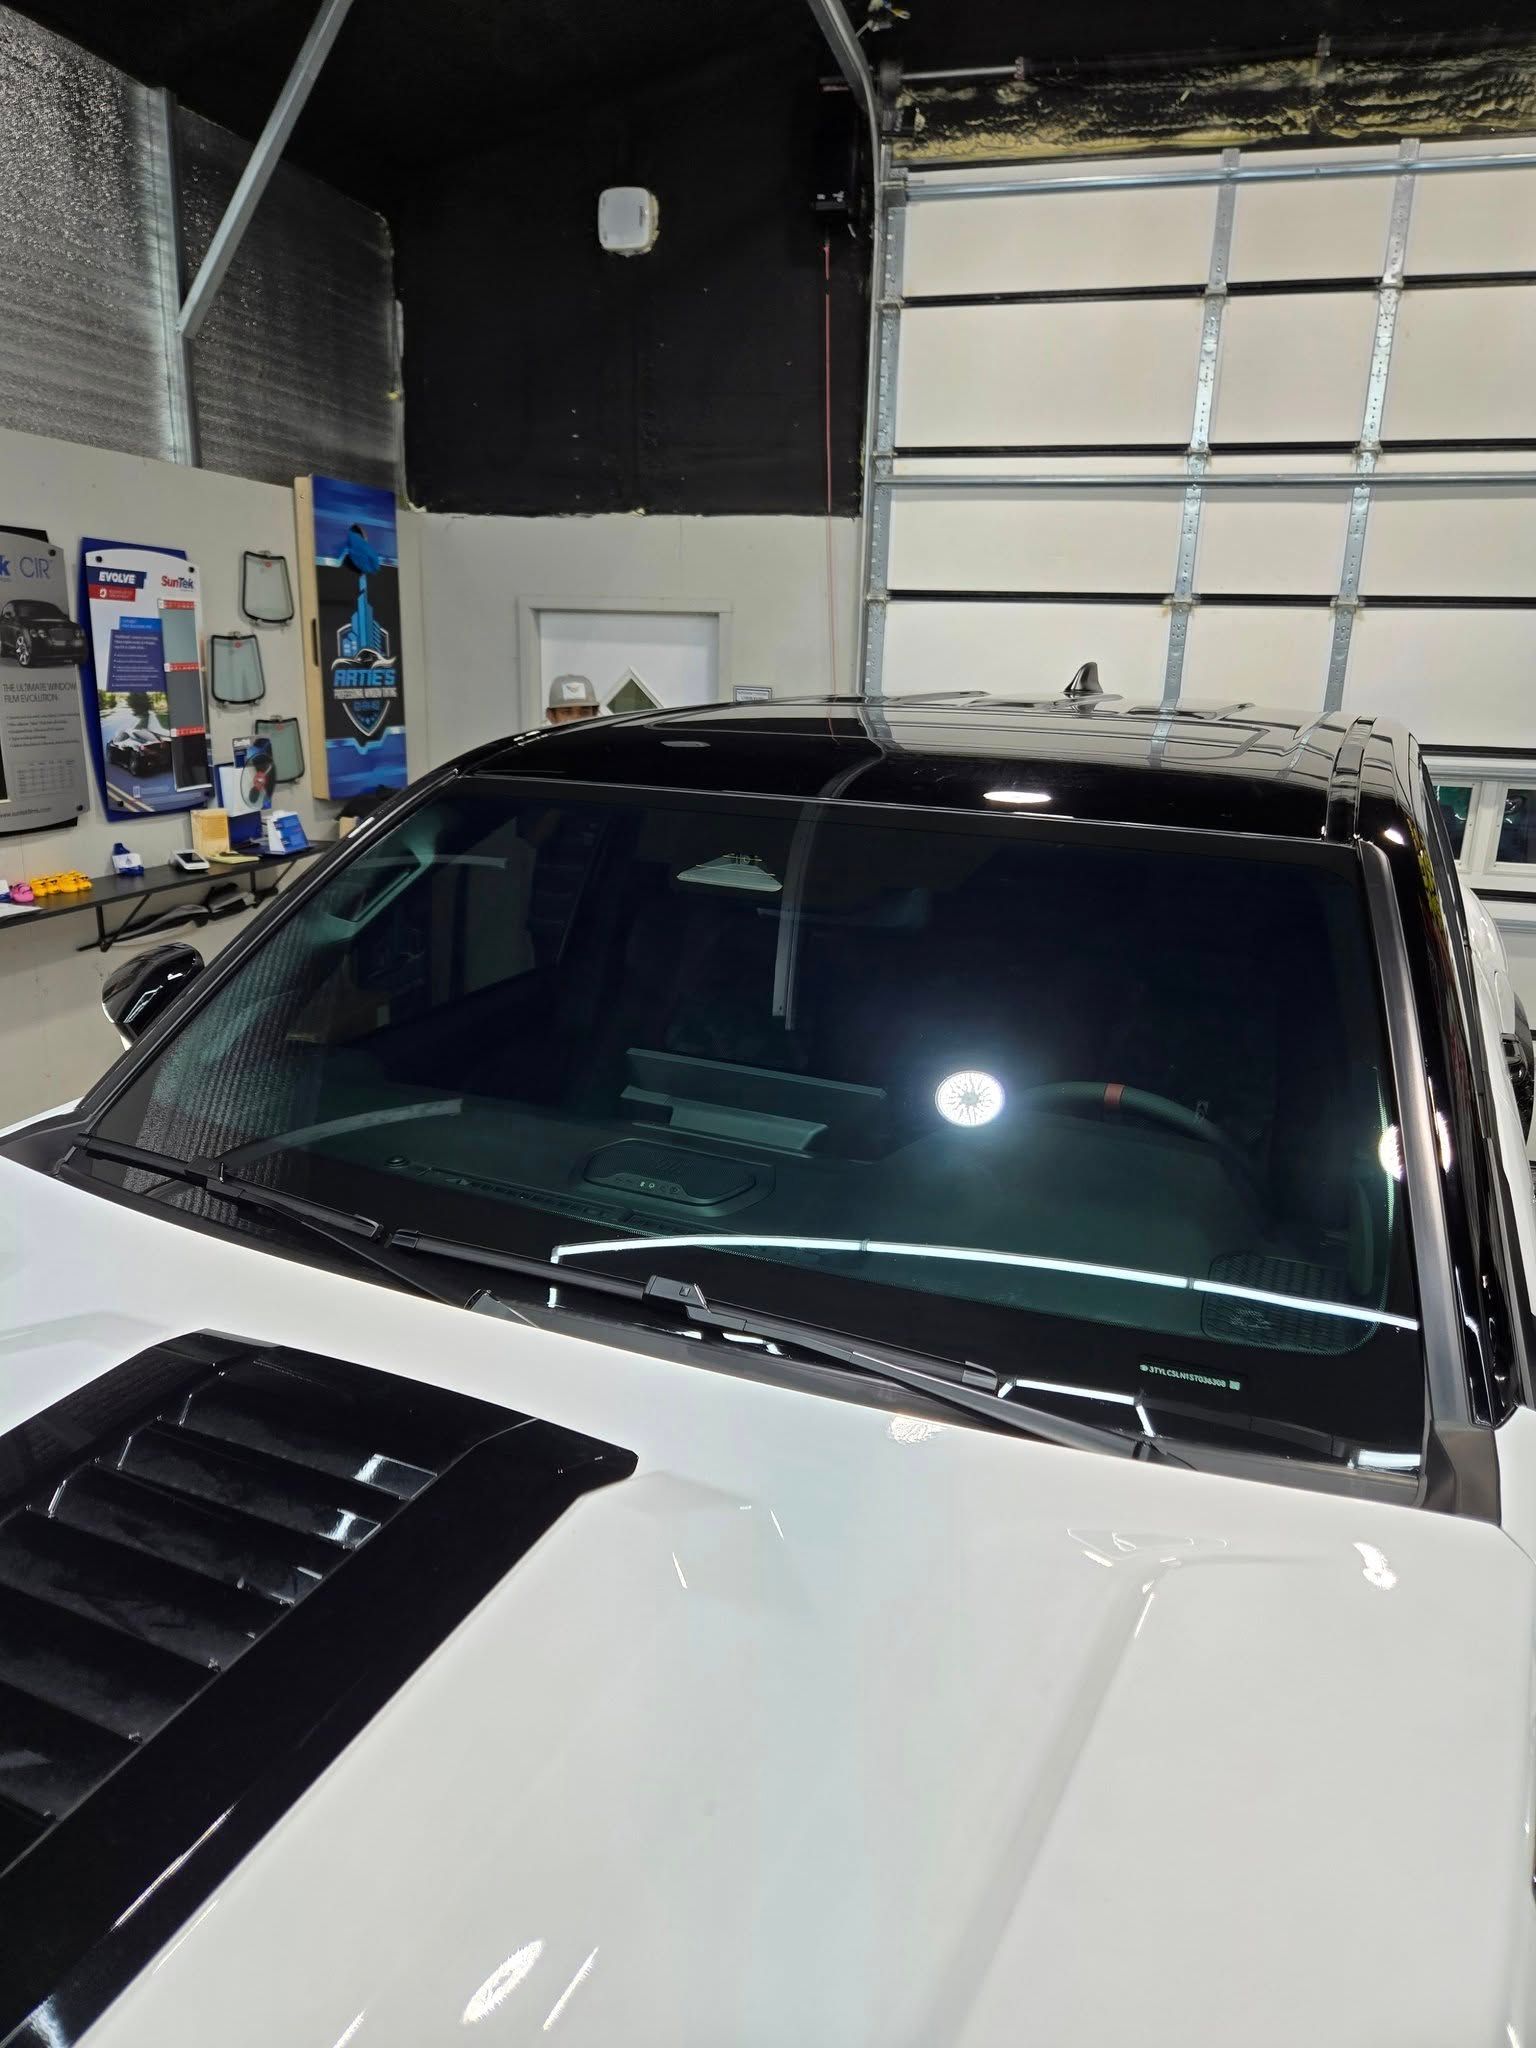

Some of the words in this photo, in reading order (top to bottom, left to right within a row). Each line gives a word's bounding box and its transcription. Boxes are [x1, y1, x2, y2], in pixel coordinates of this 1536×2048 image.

[20, 556, 50, 579] CIR
[99, 571, 136, 584] EVOLVE
[161, 575, 194, 589] SunTek
